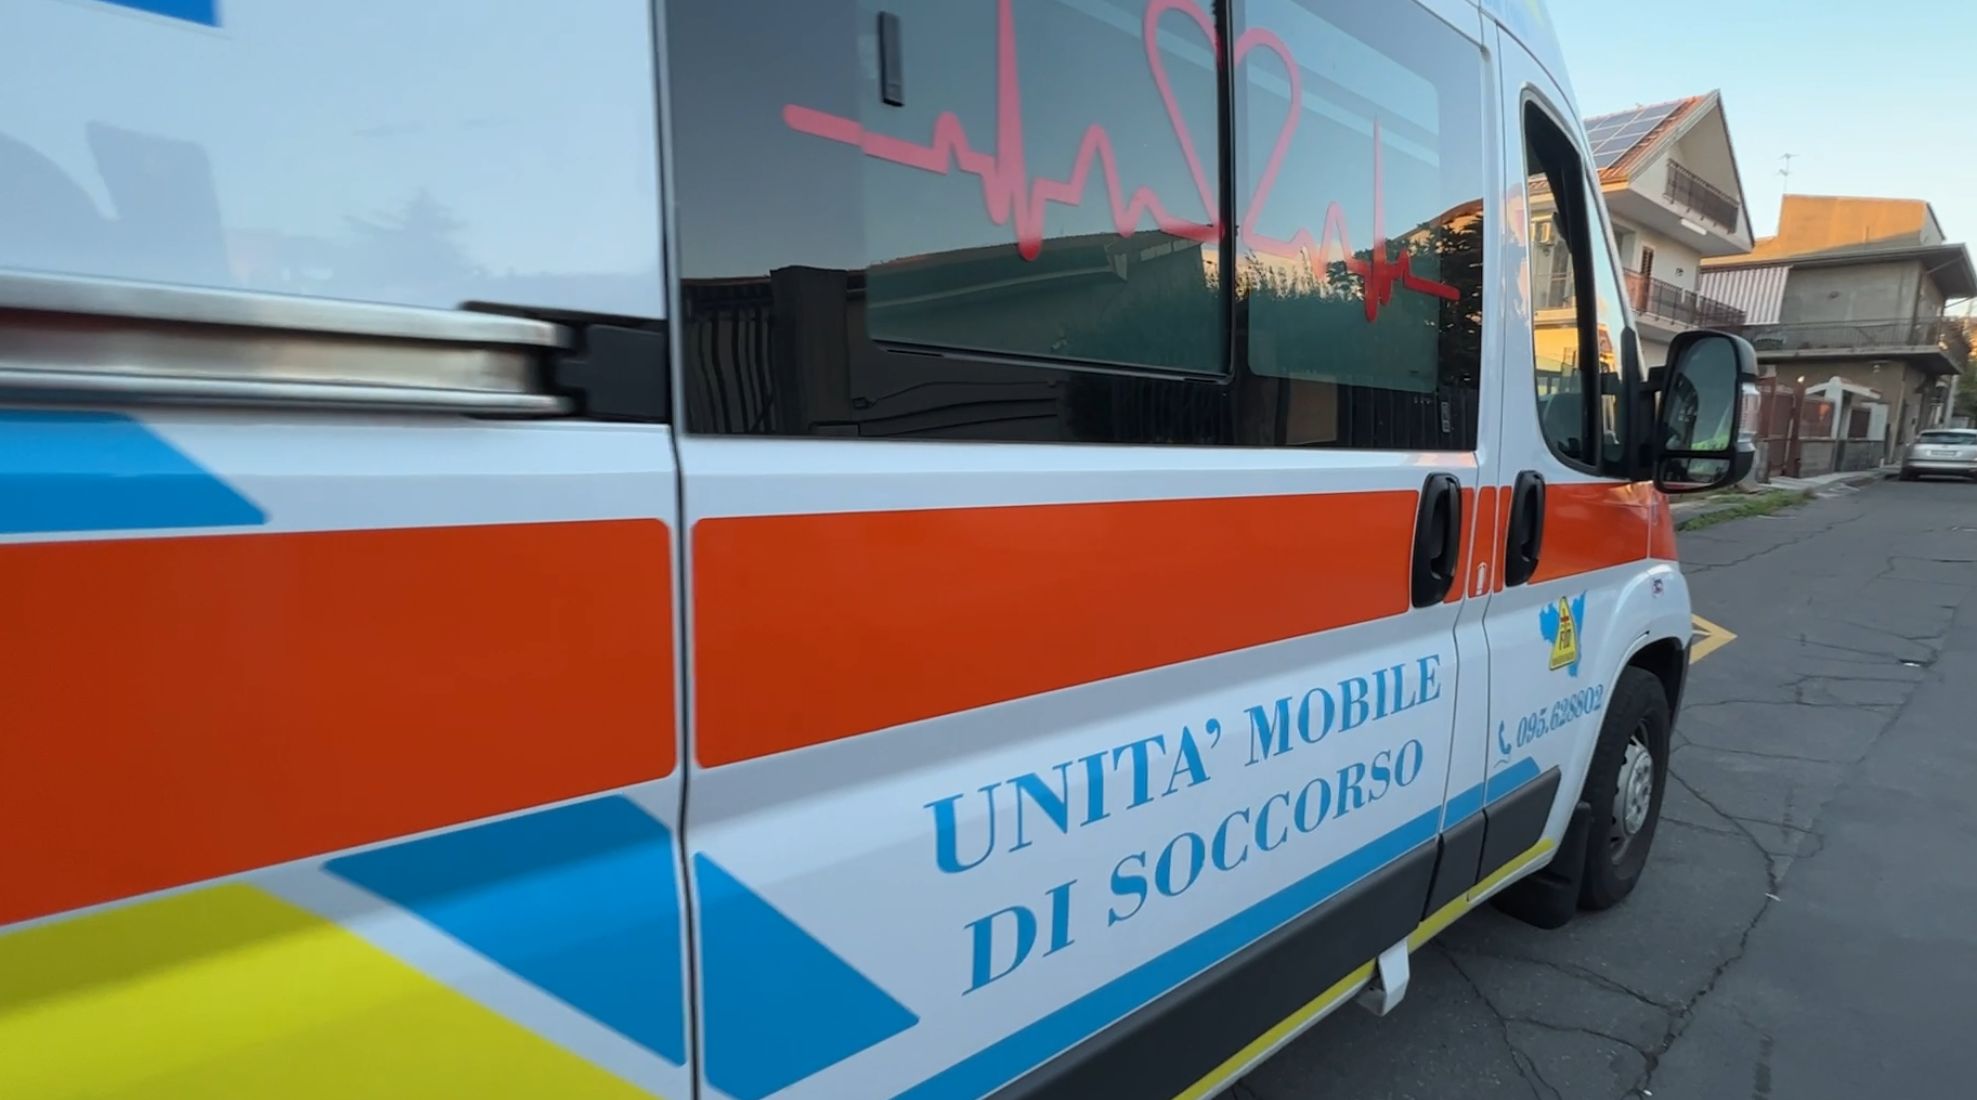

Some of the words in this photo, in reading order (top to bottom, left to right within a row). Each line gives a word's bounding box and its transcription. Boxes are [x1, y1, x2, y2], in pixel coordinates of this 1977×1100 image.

[1243, 654, 1442, 767] MOBILE
[1516, 683, 1604, 748] 095.628802
[962, 879, 1078, 996] DI
[1107, 739, 1424, 928] SOCCORSO
